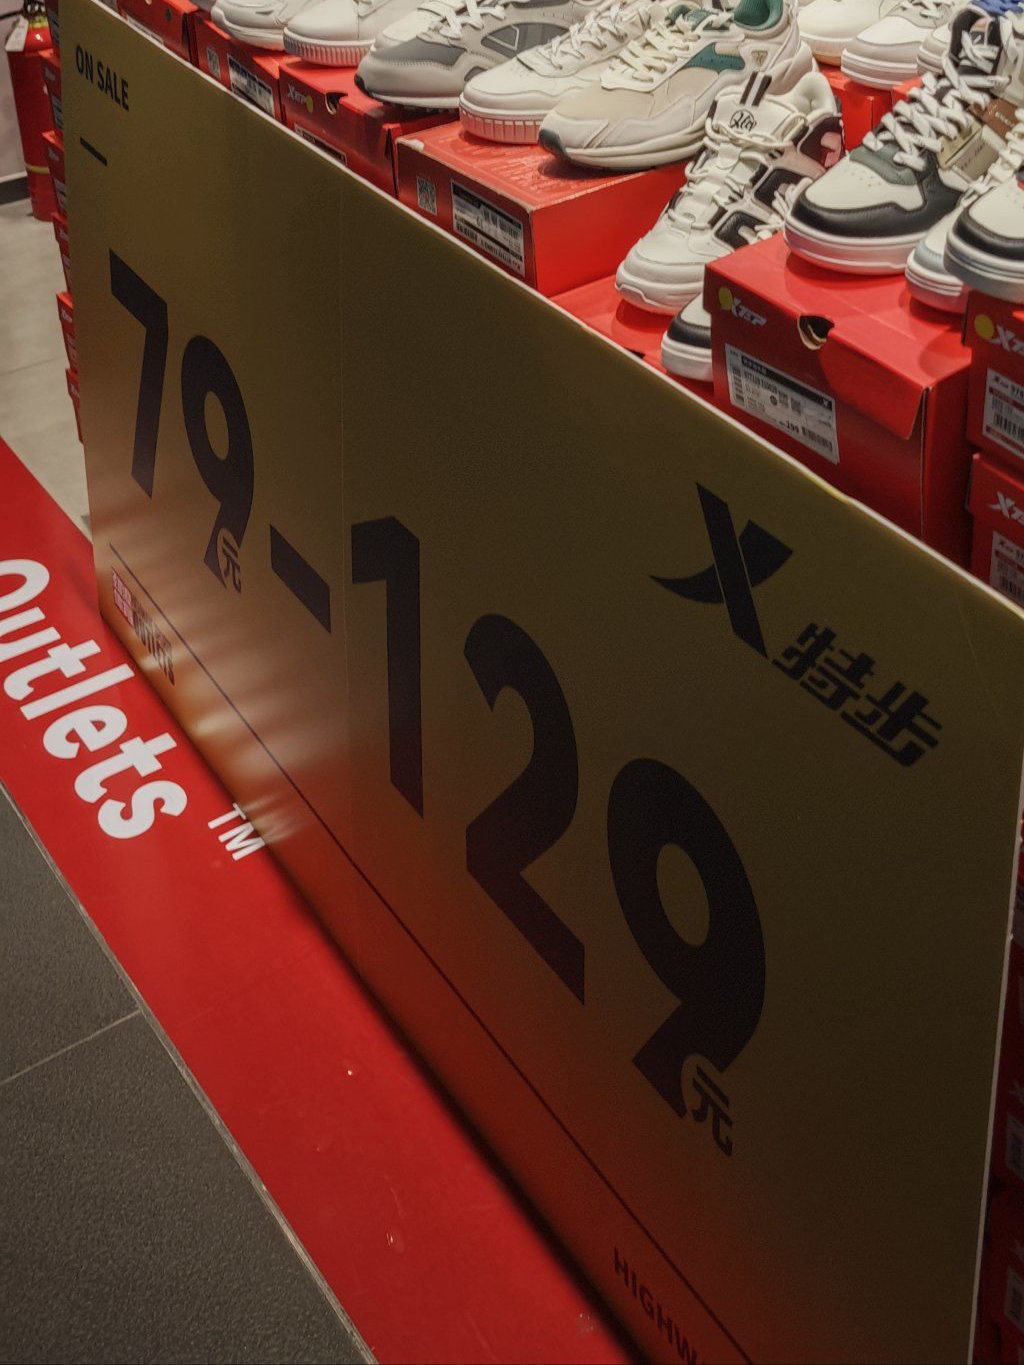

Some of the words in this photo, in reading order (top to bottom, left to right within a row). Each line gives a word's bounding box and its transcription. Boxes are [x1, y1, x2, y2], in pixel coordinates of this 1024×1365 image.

[75, 45, 94, 78] ON
[97, 61, 130, 112] SALE
[771, 620, 944, 768] 特步
[207, 802, 266, 861] TM
[613, 1247, 706, 1365] HIGHW
